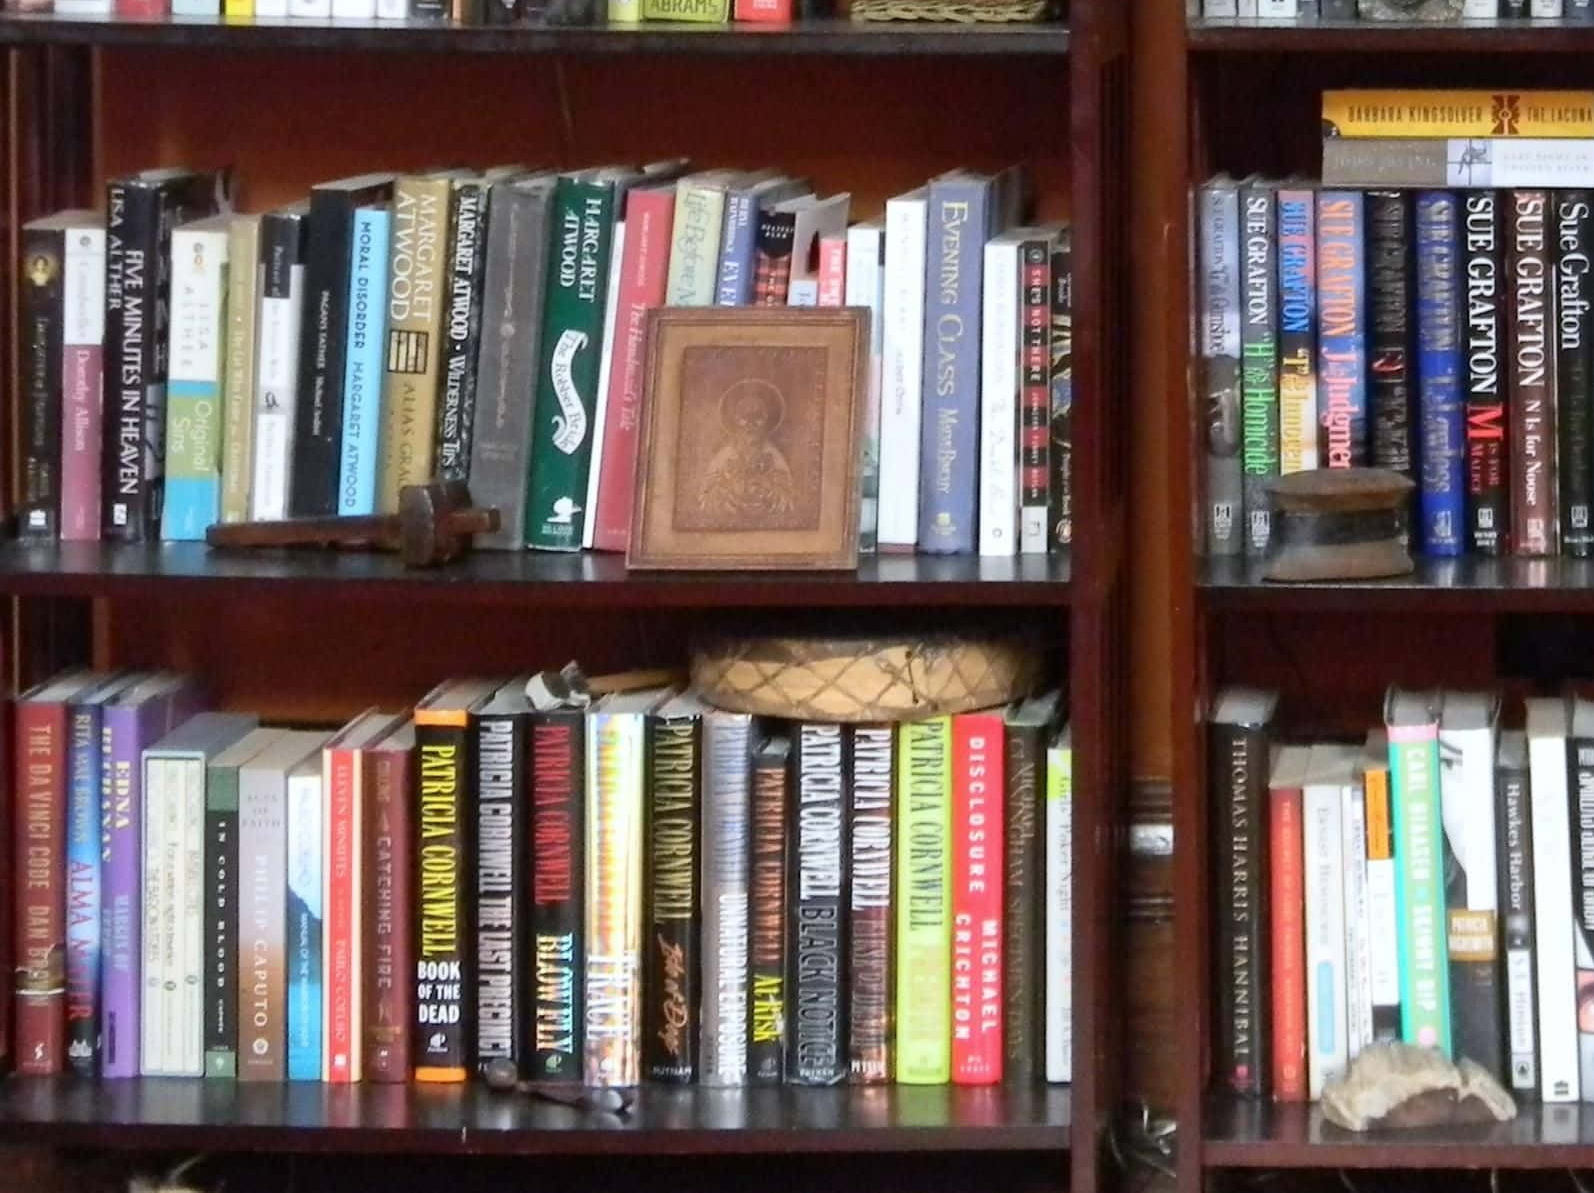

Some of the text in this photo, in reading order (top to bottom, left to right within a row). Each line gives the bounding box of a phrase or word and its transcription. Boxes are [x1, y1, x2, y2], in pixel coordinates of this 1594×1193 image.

[108, 188, 125, 311] LISA ALTHER
[352, 220, 374, 350] MORAL DISORDER
[389, 190, 417, 321] ATWOOD
[411, 191, 439, 322] MARGARET
[454, 196, 480, 274] MARGARET
[560, 208, 583, 288] ATWOOD
[577, 197, 602, 303] MARGARET
[1515, 197, 1546, 386] SUE GRAFTON
[1559, 201, 1591, 351] Sue Grafton
[450, 276, 475, 350] ATWOOD
[935, 200, 968, 397] EVENING CLASS
[1029, 268, 1042, 382] SHE'S NOT THERE
[1466, 197, 1498, 394] SUE GRAFTON
[117, 249, 145, 496] FIVE MINUTES IN HEAVEN
[443, 355, 466, 439] WILDERNESS
[554, 333, 585, 451] The Robber Bride
[1466, 401, 1504, 441] M
[1524, 398, 1541, 413] N
[171, 415, 189, 453] Sins
[193, 400, 214, 471] Original
[1525, 434, 1541, 456] for
[1525, 460, 1541, 506] Noose
[421, 744, 457, 957] PATRICIA CORNWELL
[968, 736, 986, 894] DISCLOSURE
[1507, 782, 1525, 910] Hawkes Harbor
[1230, 737, 1254, 1058] THOMAS HARRIS HANNIBAL
[417, 960, 461, 981] BOOK
[417, 983, 461, 1000] OF THE
[418, 1003, 461, 1024] DEAD
[478, 896, 513, 1057] THE LAST PRECINCT
[535, 932, 574, 1054] BLOW FLY
[954, 913, 972, 1040] CRICHTON
[980, 917, 998, 1034] MICHAEL
